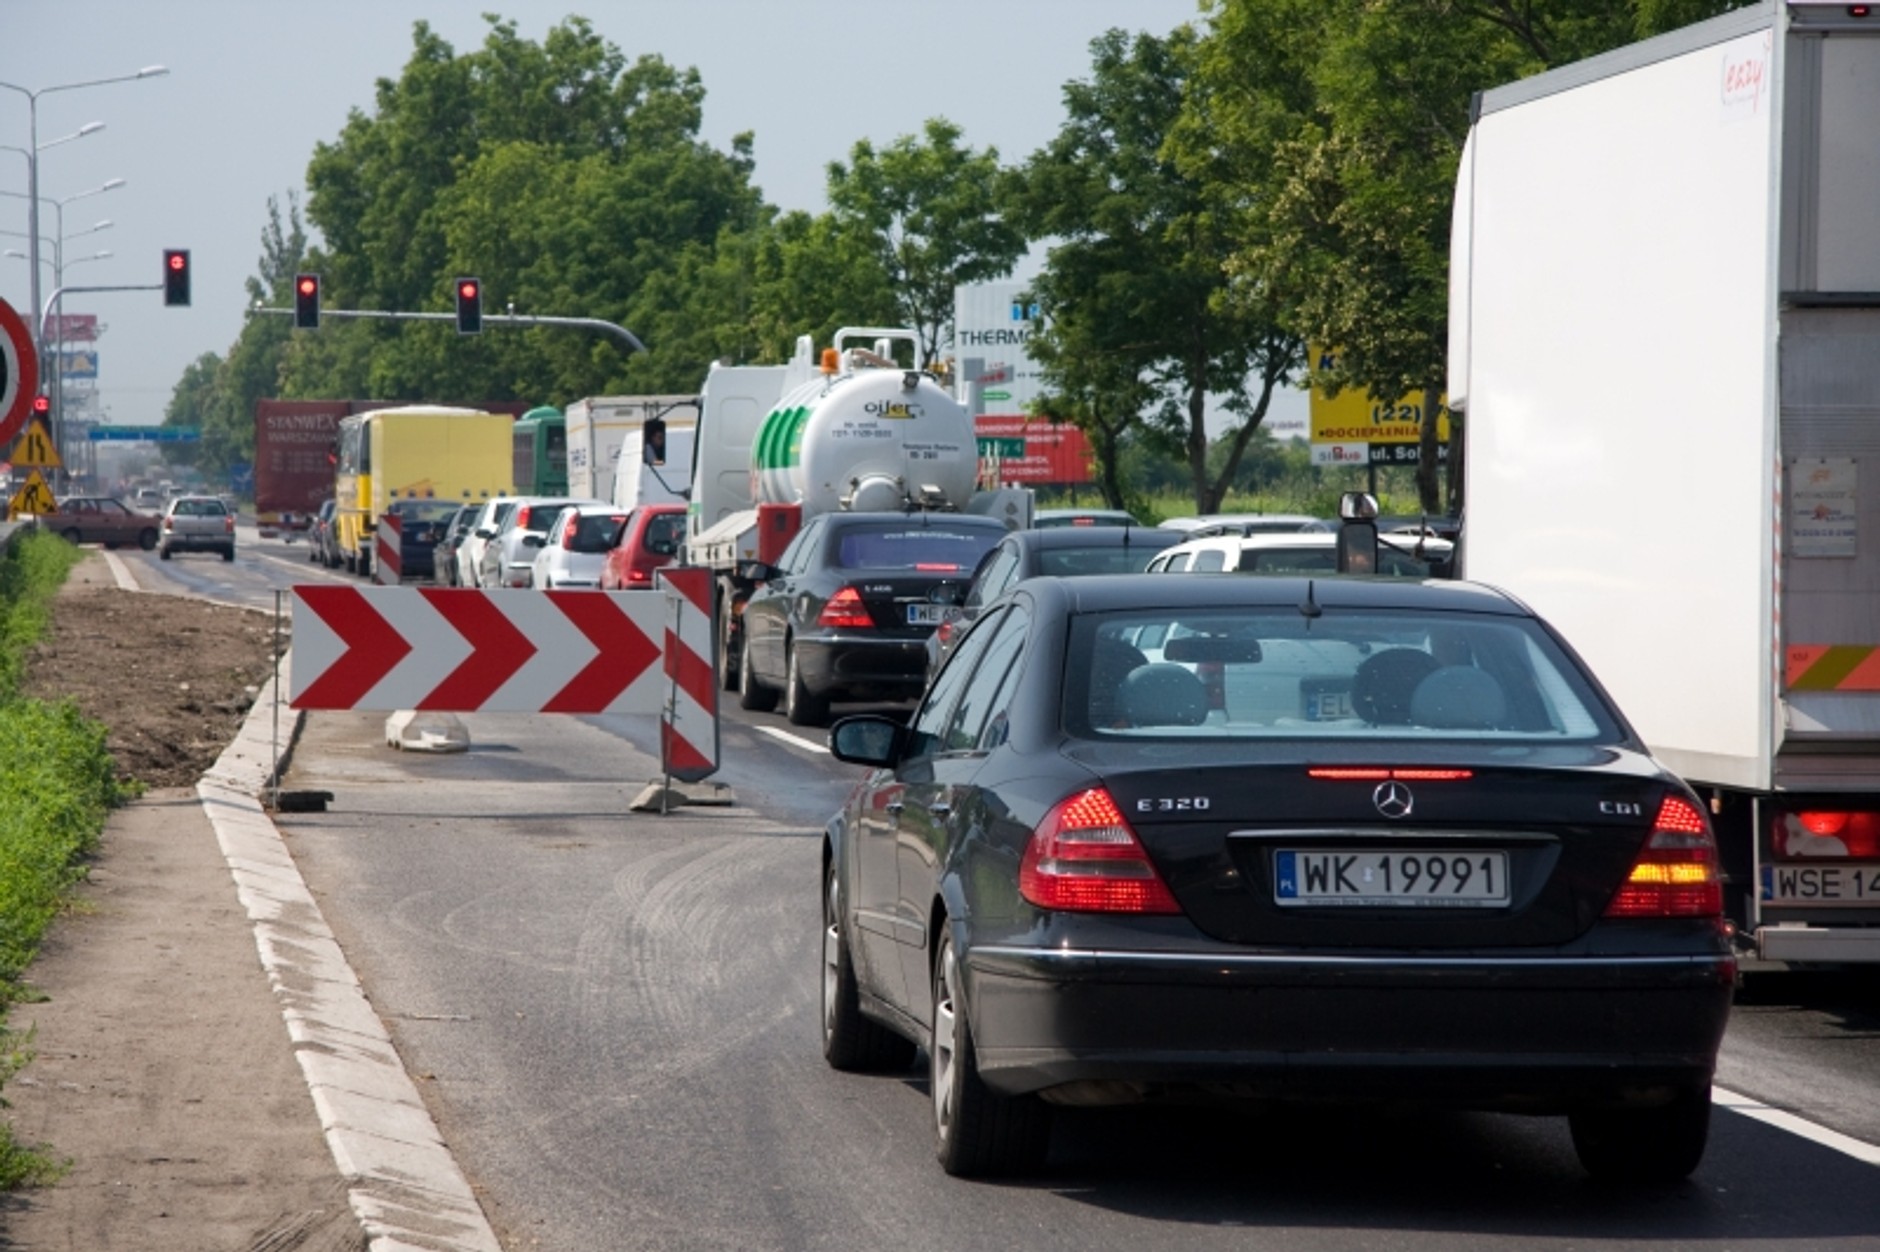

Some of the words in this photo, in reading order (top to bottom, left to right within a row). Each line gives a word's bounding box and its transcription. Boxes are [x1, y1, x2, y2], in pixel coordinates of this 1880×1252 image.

[266, 413, 336, 430] STANWEX
[1373, 405, 1421, 424] (22)
[1370, 447, 1391, 460] ul.
[1137, 799, 1152, 812] E
[1158, 797, 1210, 811] 320
[1599, 801, 1641, 815] CDI
[1304, 855, 1360, 894] WK
[1378, 855, 1493, 895] 19991
[1779, 869, 1841, 898] WSE
